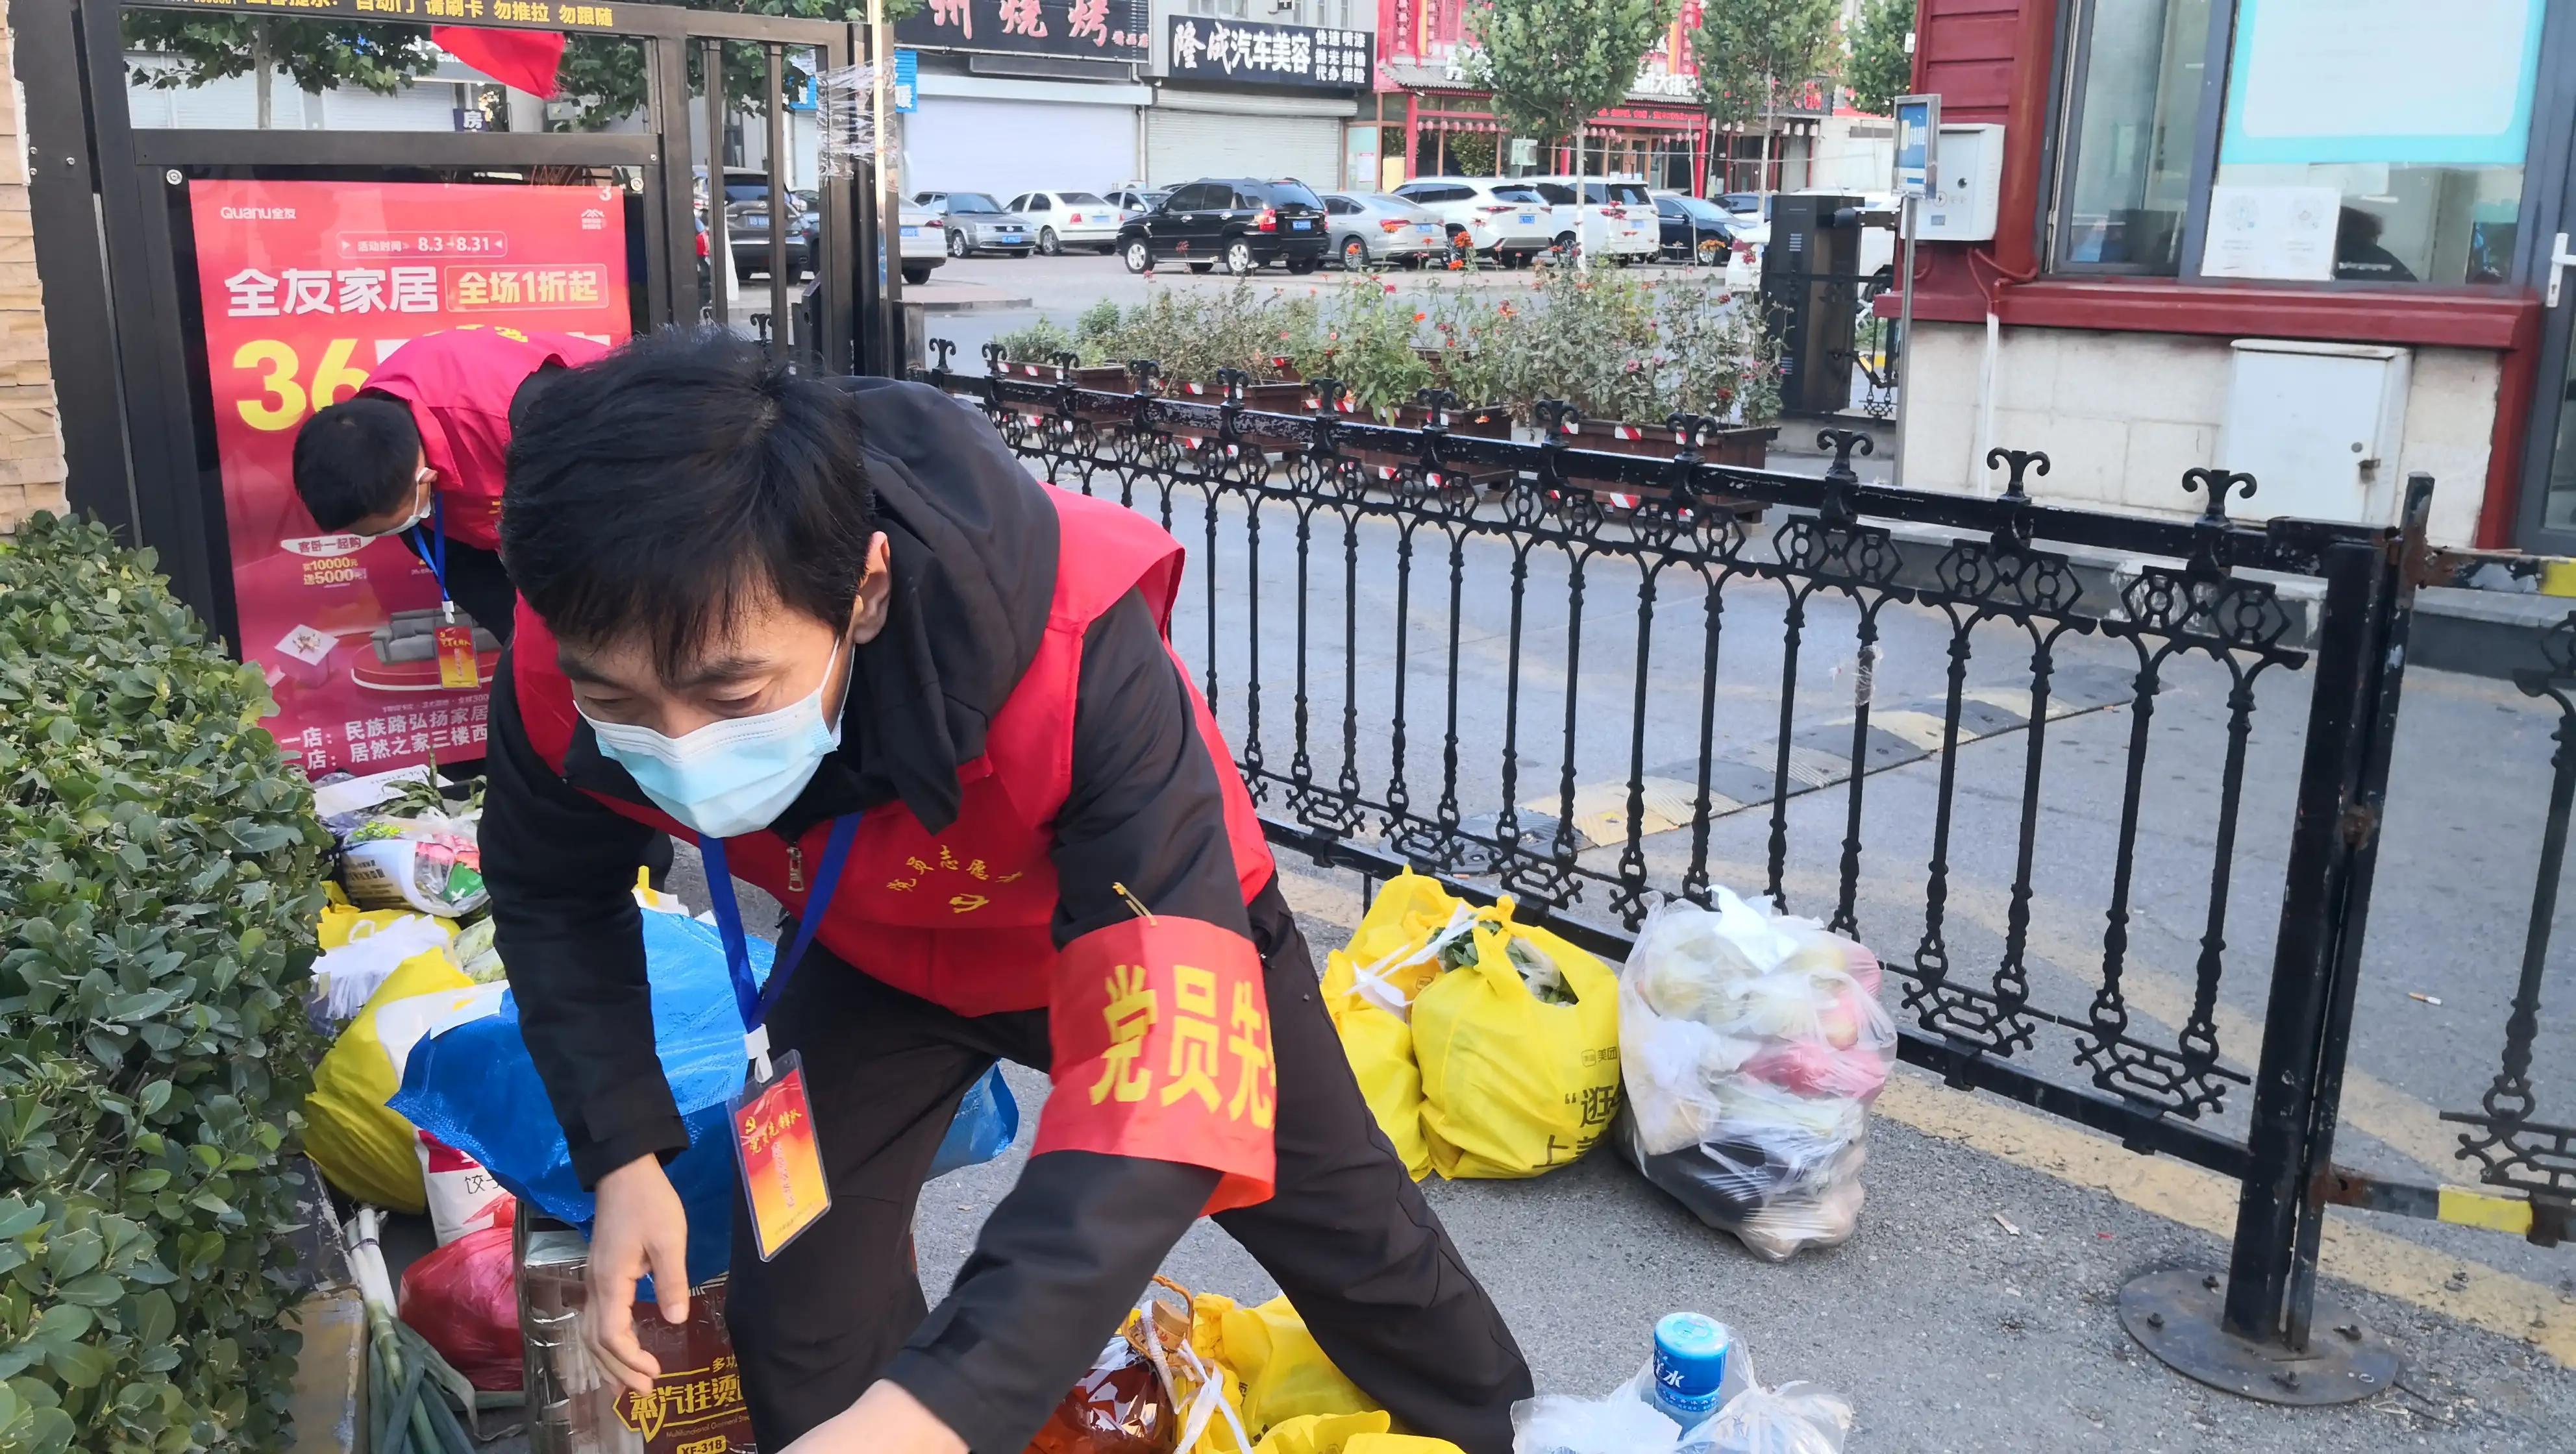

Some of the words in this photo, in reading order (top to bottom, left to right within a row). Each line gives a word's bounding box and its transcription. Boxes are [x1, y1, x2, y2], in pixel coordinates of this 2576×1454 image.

[426, 0, 484, 18] 请刷卡
[493, 1, 551, 23] 勿推拉
[559, 5, 613, 27] 勿跟随
[224, 266, 438, 317] 全友家居
[458, 270, 599, 304] 全场1折起
[345, 705, 488, 742] 民族路弘扬家居
[1088, 965, 1276, 1130] 党员先
[1598, 1046, 1617, 1063] 美团
[713, 1354, 737, 1373] 多功
[629, 1374, 743, 1420] 蒸汽挂烫
